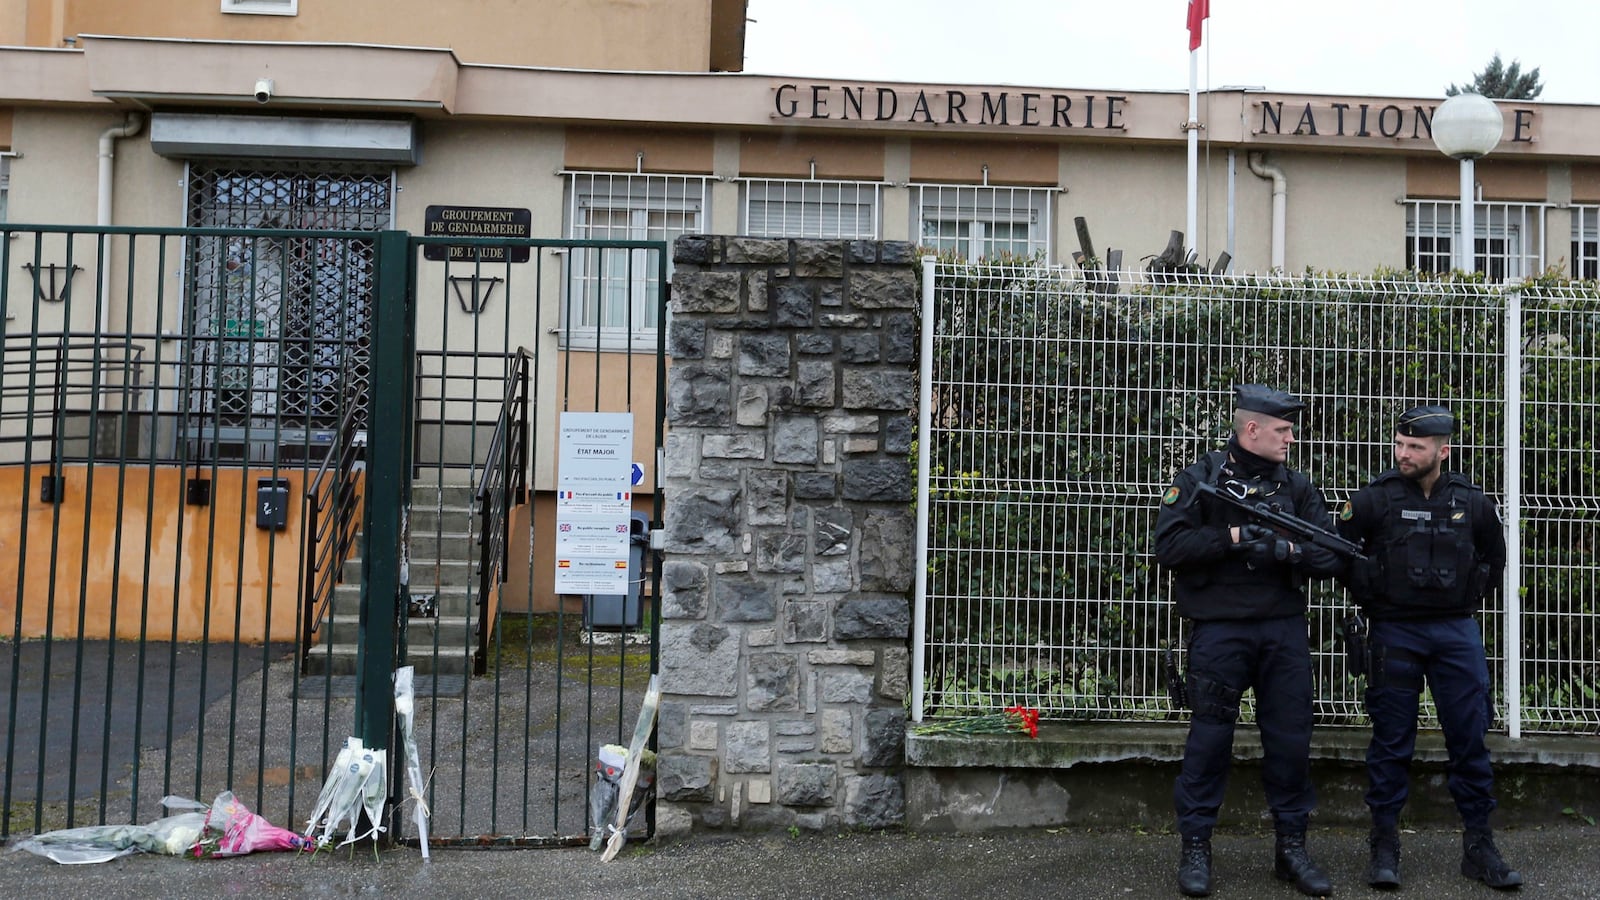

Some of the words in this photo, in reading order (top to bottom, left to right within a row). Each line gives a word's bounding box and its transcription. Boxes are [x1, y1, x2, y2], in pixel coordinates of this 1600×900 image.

[775, 84, 1126, 129] GENDARMERIE
[1260, 101, 1534, 142] NATIONE
[442, 210, 514, 221] GROUPEMENT
[431, 222, 445, 232] DE
[448, 223, 525, 234] GENDARMERIE
[450, 247, 464, 257] DE
